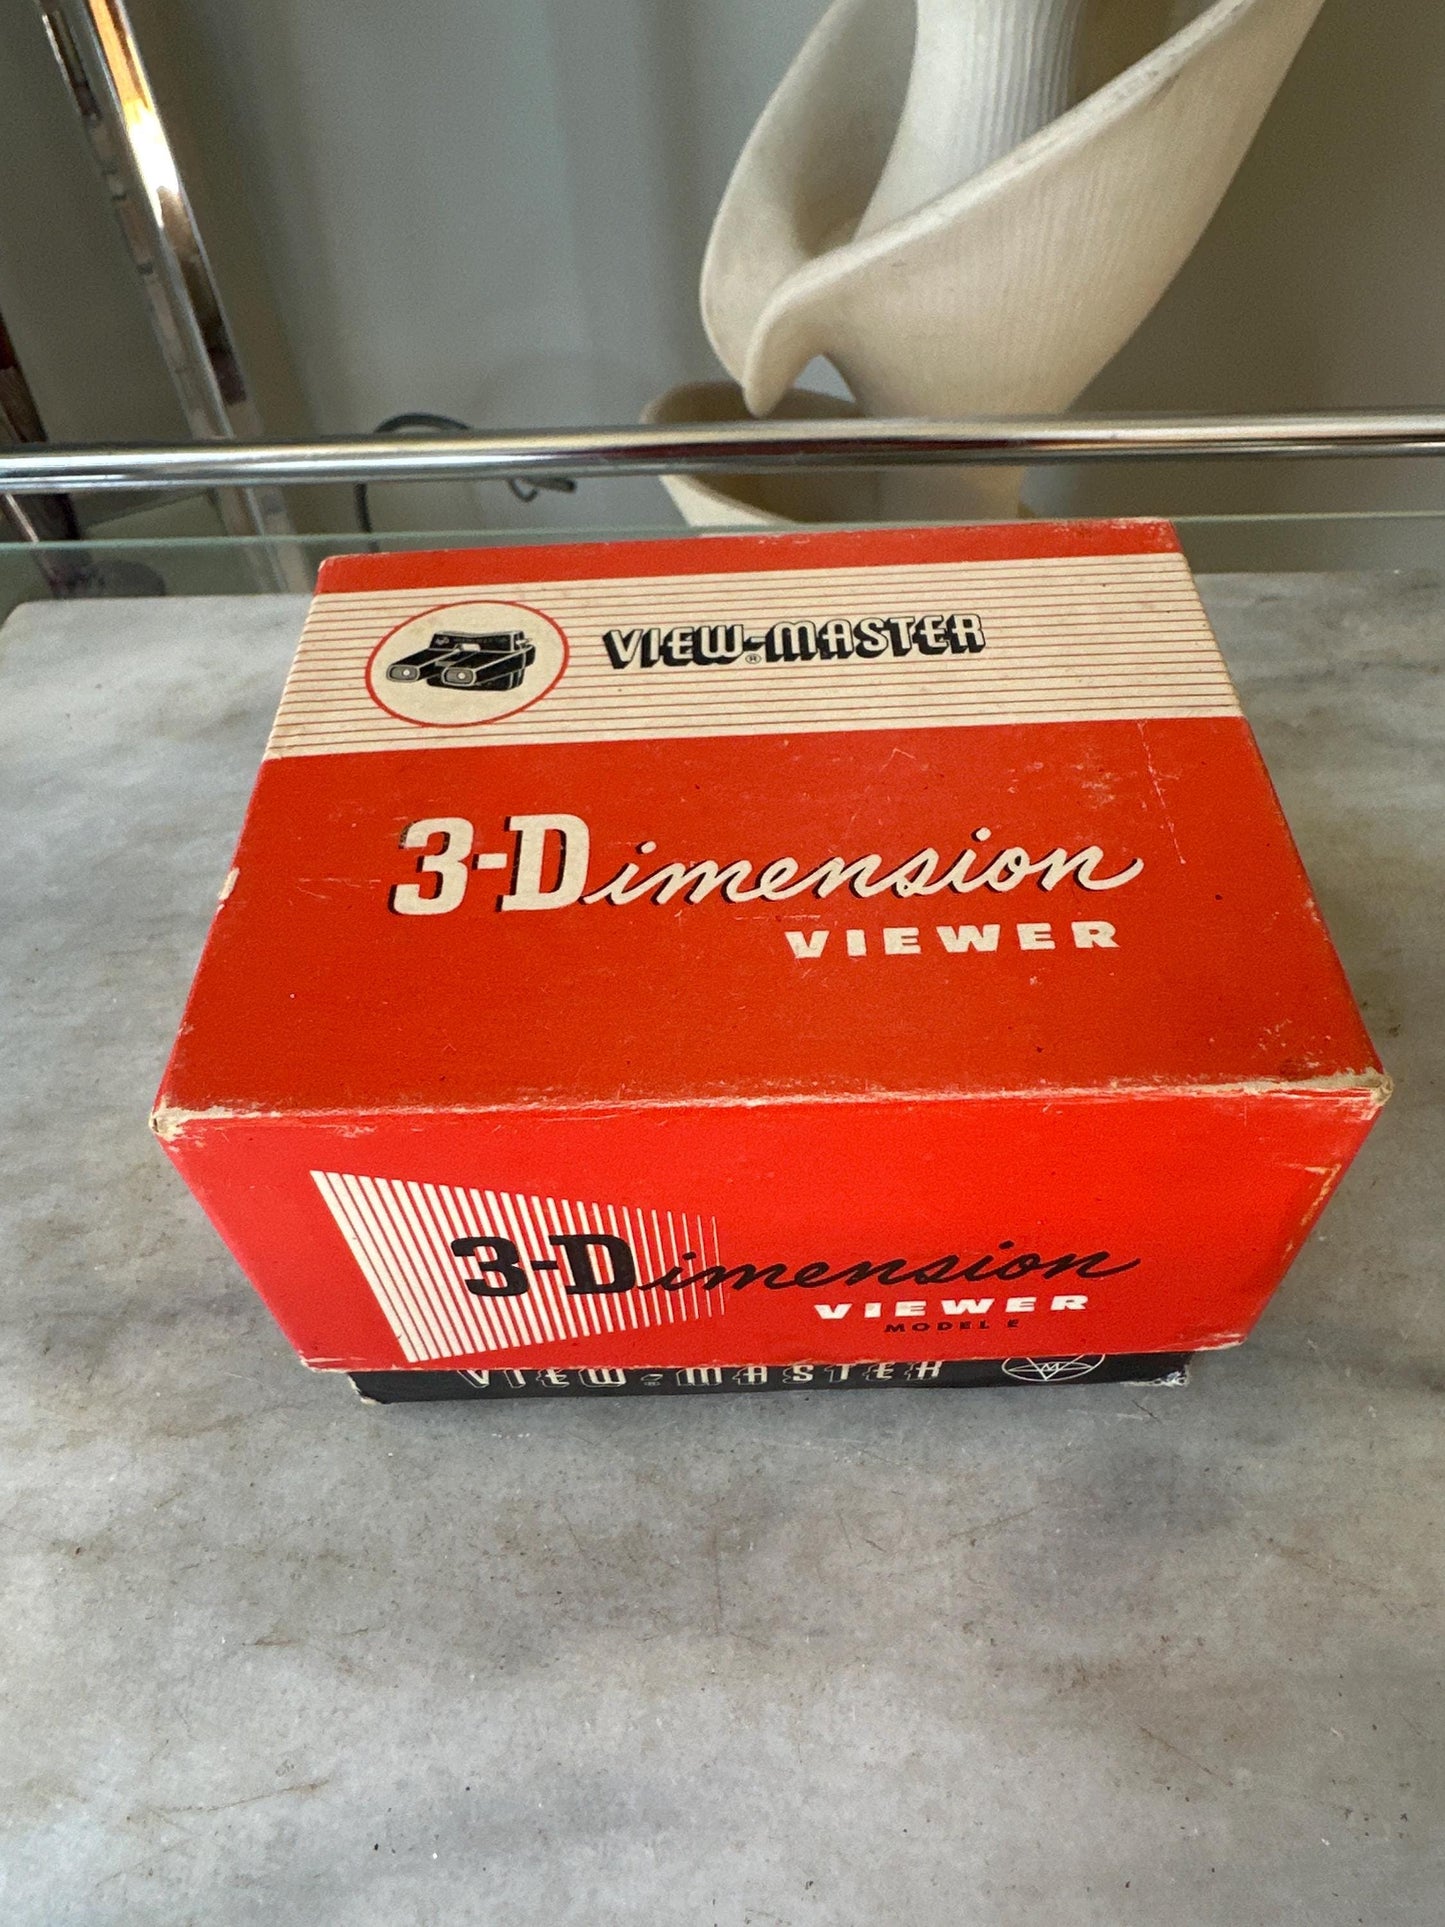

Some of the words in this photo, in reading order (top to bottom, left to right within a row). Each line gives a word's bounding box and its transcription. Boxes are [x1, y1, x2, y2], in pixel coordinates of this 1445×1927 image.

[602, 613, 987, 669] VIEW-MASTER
[388, 813, 1144, 917] 3-Dimension
[785, 920, 1121, 959] VIEWER
[450, 1234, 1141, 1297] 3-Dimension
[813, 1294, 1089, 1320] VIEWER
[884, 1319, 991, 1333] MODEL
[1007, 1318, 1021, 1329] E
